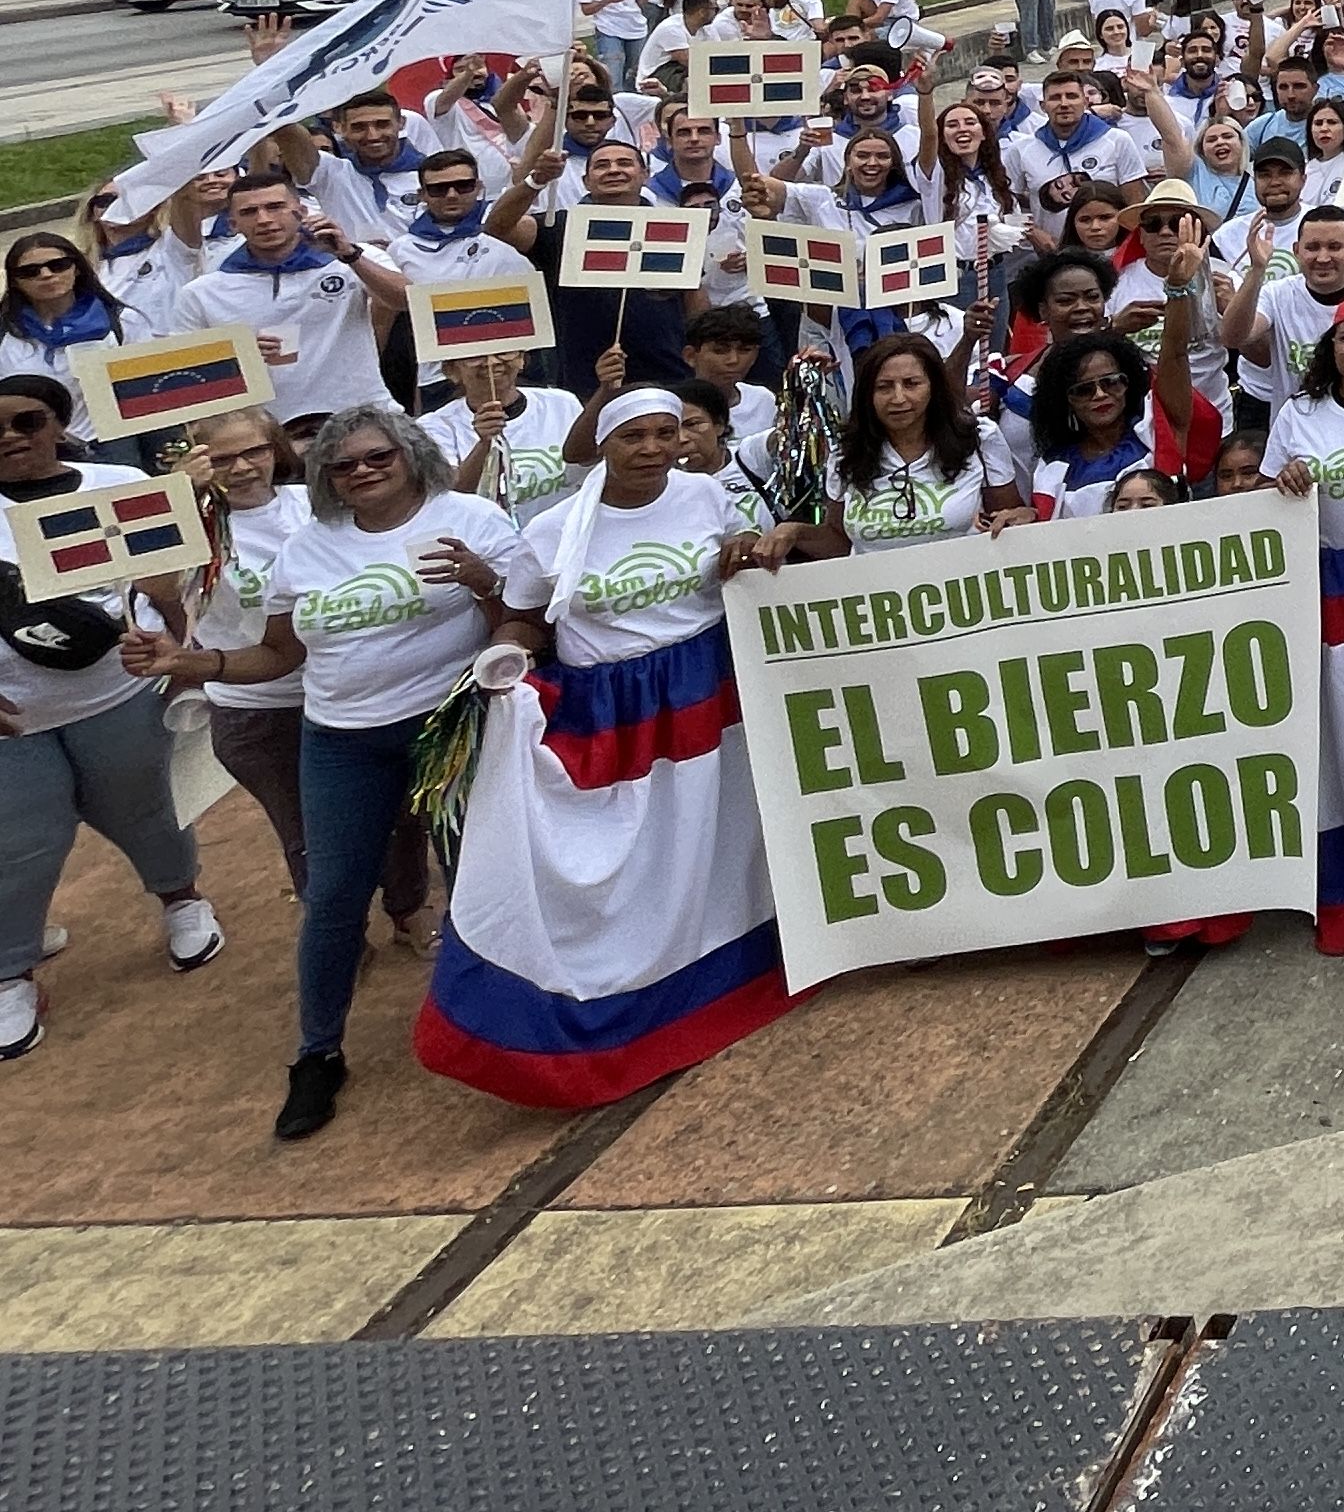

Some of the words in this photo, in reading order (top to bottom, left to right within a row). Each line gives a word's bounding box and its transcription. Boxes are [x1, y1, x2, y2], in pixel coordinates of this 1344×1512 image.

[759, 528, 1285, 655] INTERCULTURALIDAD
[784, 685, 905, 796] EL
[917, 619, 1294, 777] BIERZO
[811, 805, 947, 924] ES
[968, 753, 1303, 897] COLOR
